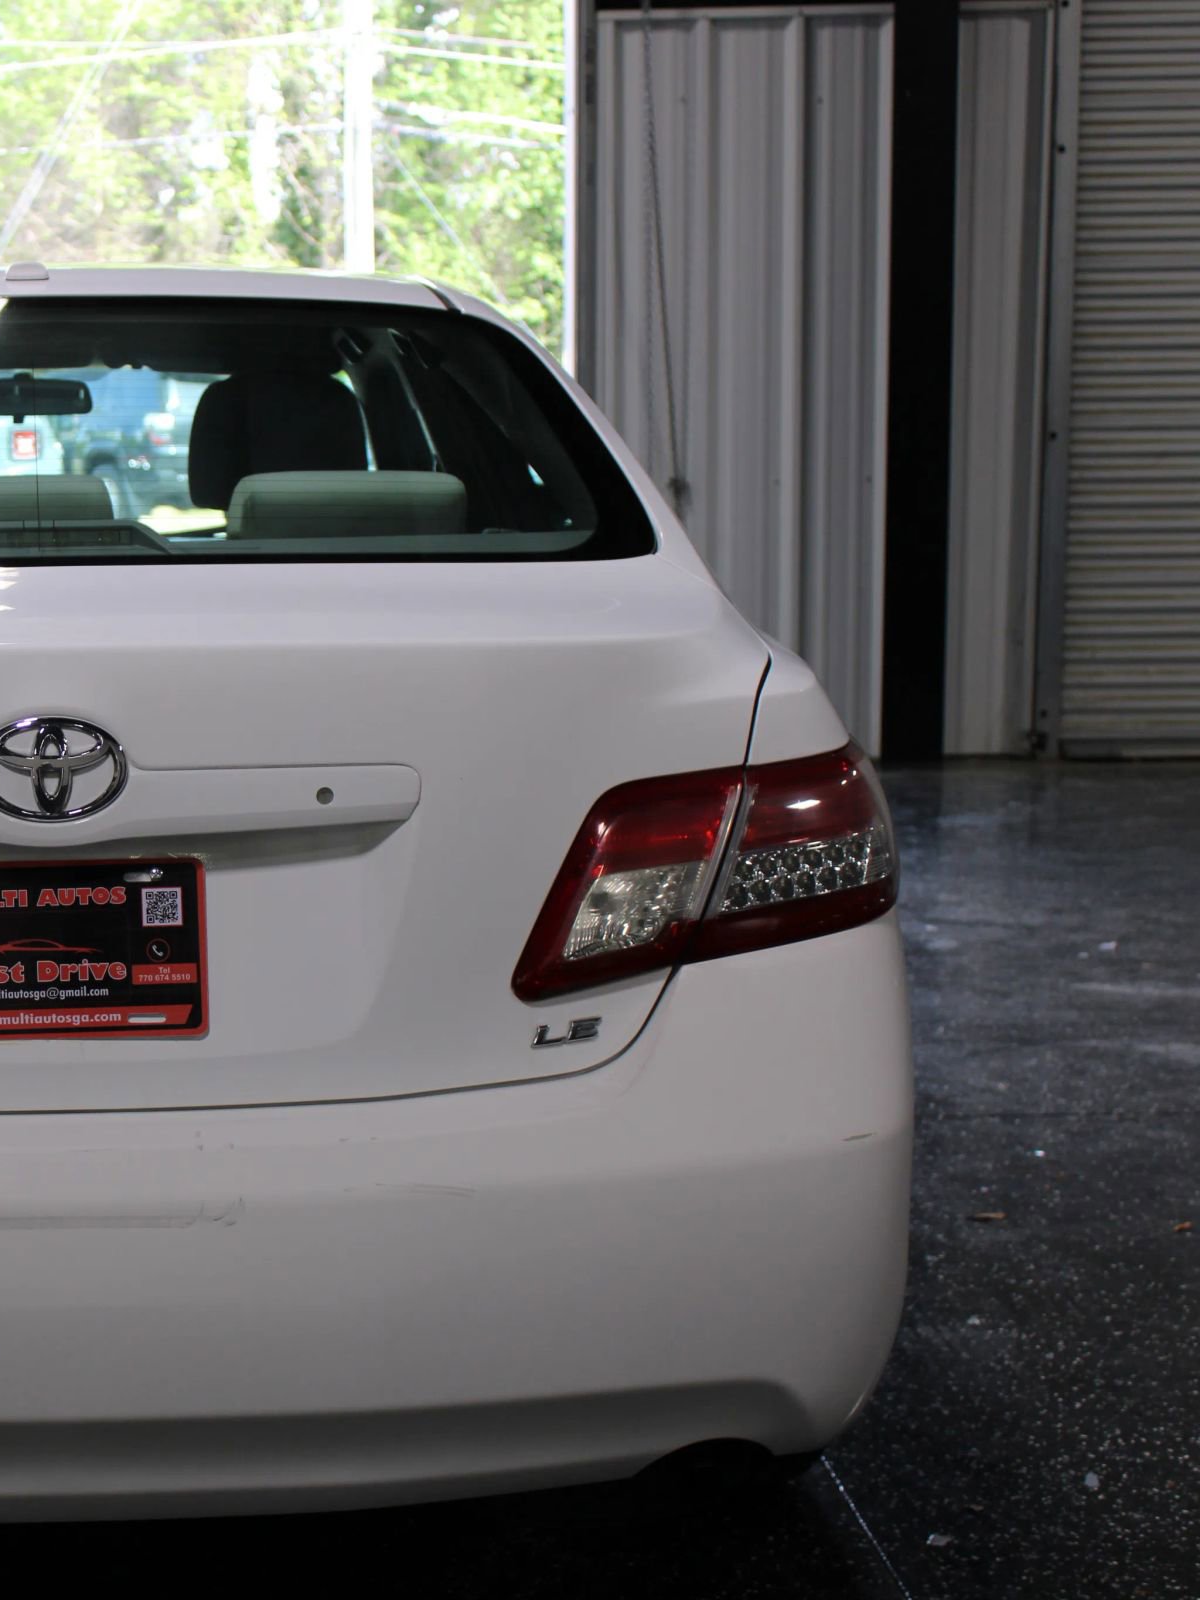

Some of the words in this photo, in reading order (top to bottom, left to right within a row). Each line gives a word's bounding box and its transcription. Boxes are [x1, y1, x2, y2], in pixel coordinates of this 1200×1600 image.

[36, 886, 127, 906] AUTOS
[36, 958, 127, 983] Drive
[138, 974, 153, 982] 770
[158, 966, 171, 974] Tel
[531, 1016, 602, 1050] LE
